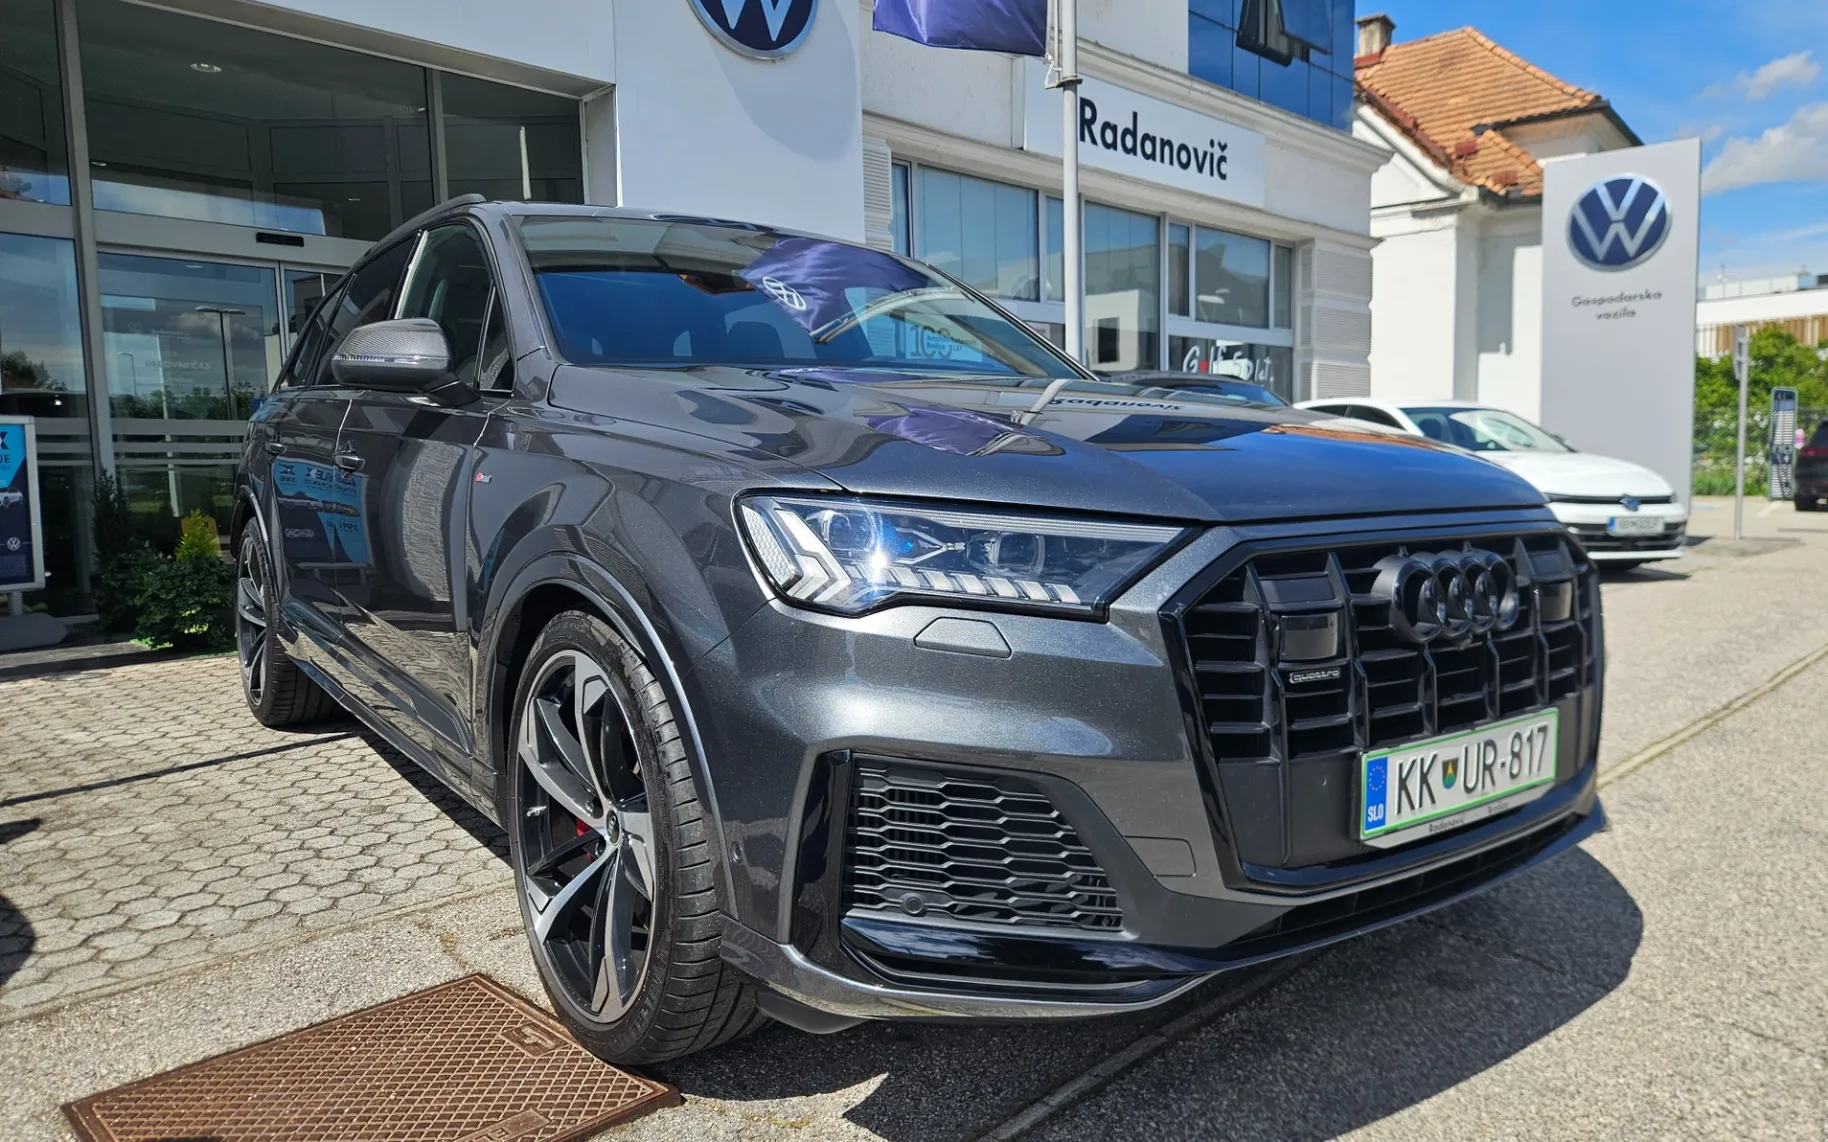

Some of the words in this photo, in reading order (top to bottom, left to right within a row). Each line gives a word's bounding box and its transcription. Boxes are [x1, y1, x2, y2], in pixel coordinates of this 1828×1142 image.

[1079, 96, 1229, 181] Radanovič
[1571, 288, 1663, 307] Gospodarska
[1292, 669, 1341, 682] quattro
[1394, 752, 1439, 817] KK
[1460, 722, 1550, 795] UR-817
[1367, 804, 1384, 822] SLO
